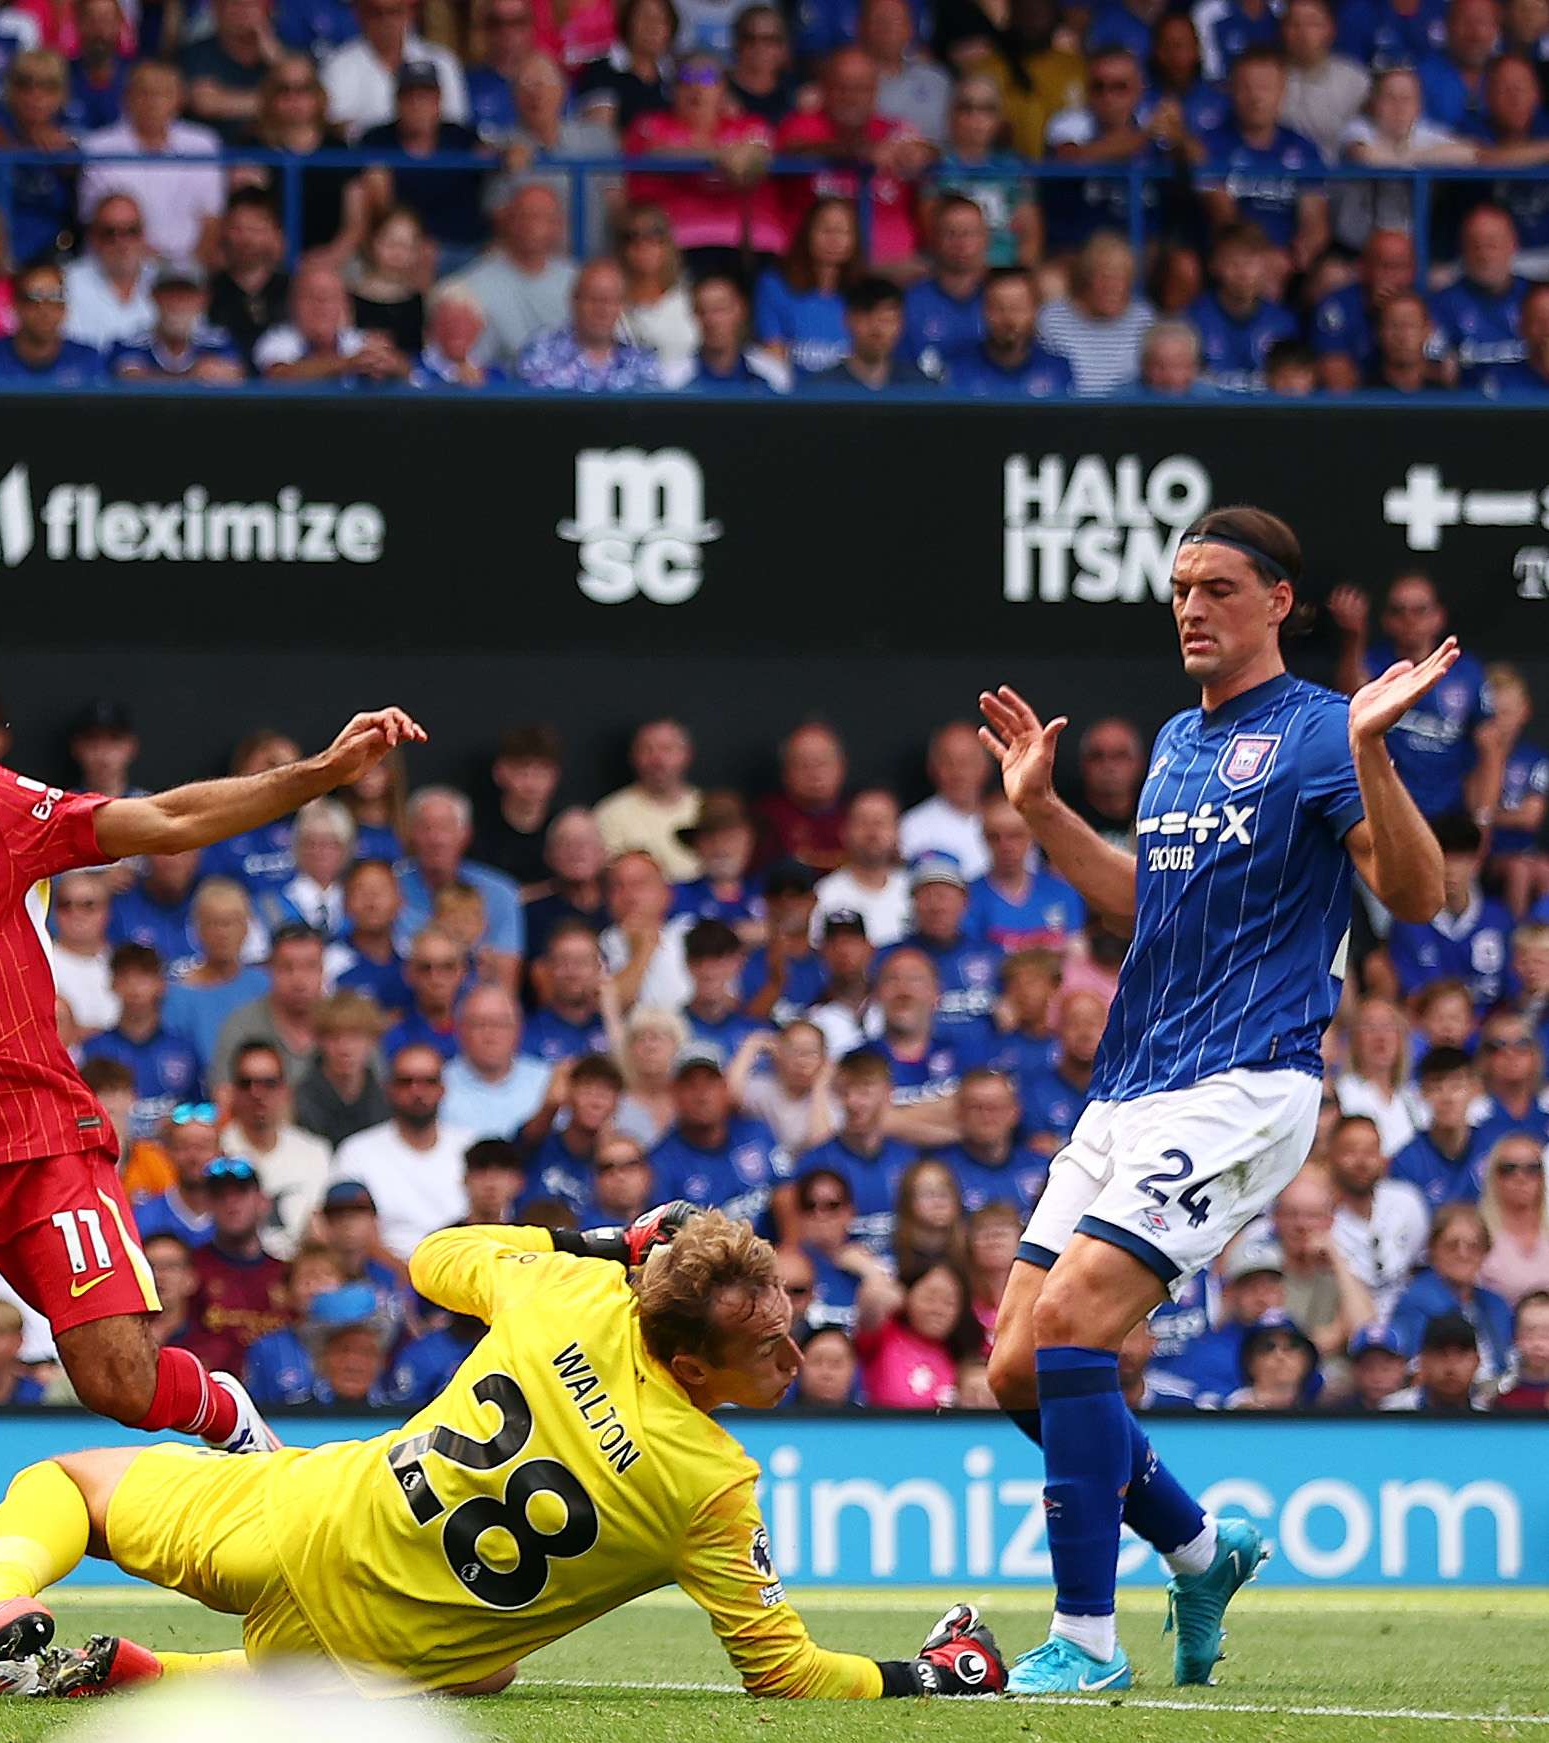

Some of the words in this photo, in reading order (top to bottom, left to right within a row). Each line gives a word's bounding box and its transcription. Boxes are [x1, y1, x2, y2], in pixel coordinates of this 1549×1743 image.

[42, 483, 385, 562] fleximize
[1004, 454, 1212, 530] HALO
[1513, 546, 1549, 600] T
[1147, 844, 1196, 873] TOUR
[1135, 1148, 1224, 1230] 24
[51, 1208, 113, 1275] 11
[551, 1341, 642, 1477] WALTON
[386, 1371, 600, 1612] 28
[916, 1662, 939, 1690] CW
